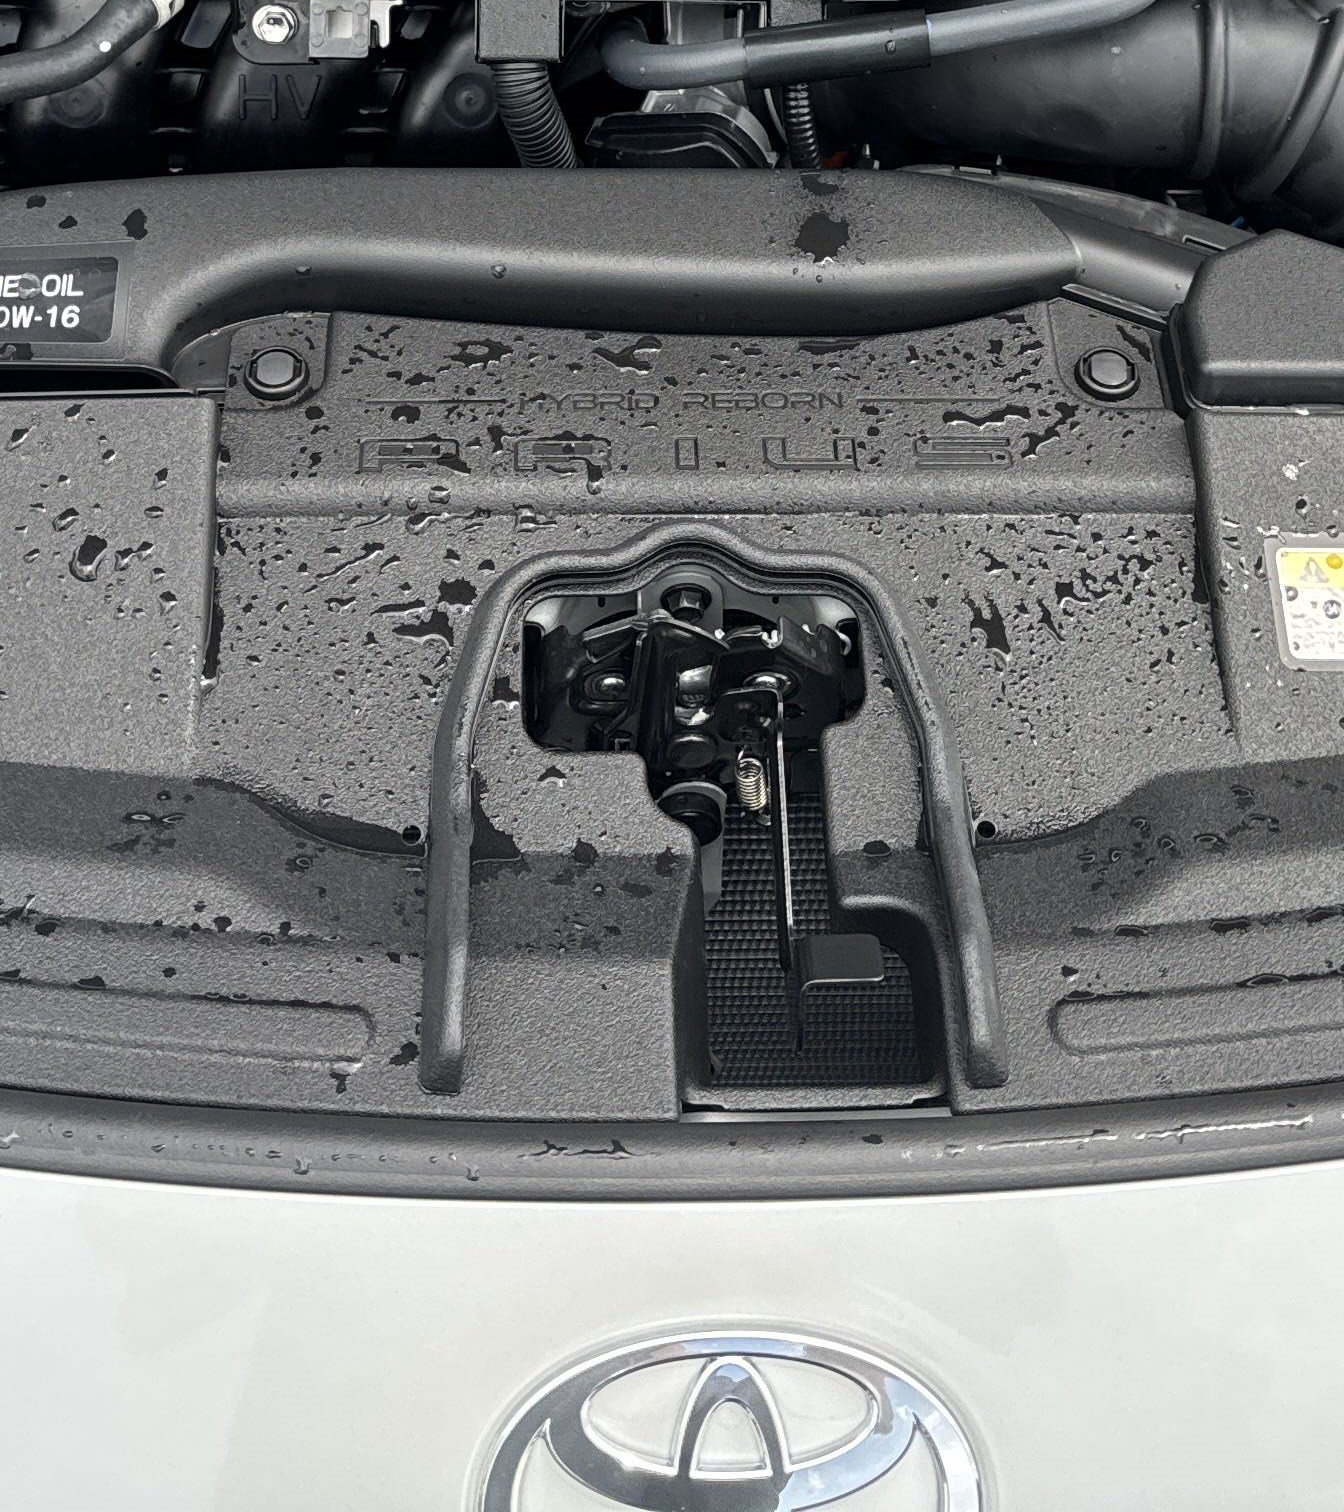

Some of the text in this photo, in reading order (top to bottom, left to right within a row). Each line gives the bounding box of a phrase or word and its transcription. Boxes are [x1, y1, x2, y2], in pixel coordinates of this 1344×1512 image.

[238, 74, 323, 121] HV
[40, 272, 85, 298] OIL
[518, 391, 844, 412] HYBRID REBORN
[357, 434, 1014, 475] PRIUS
